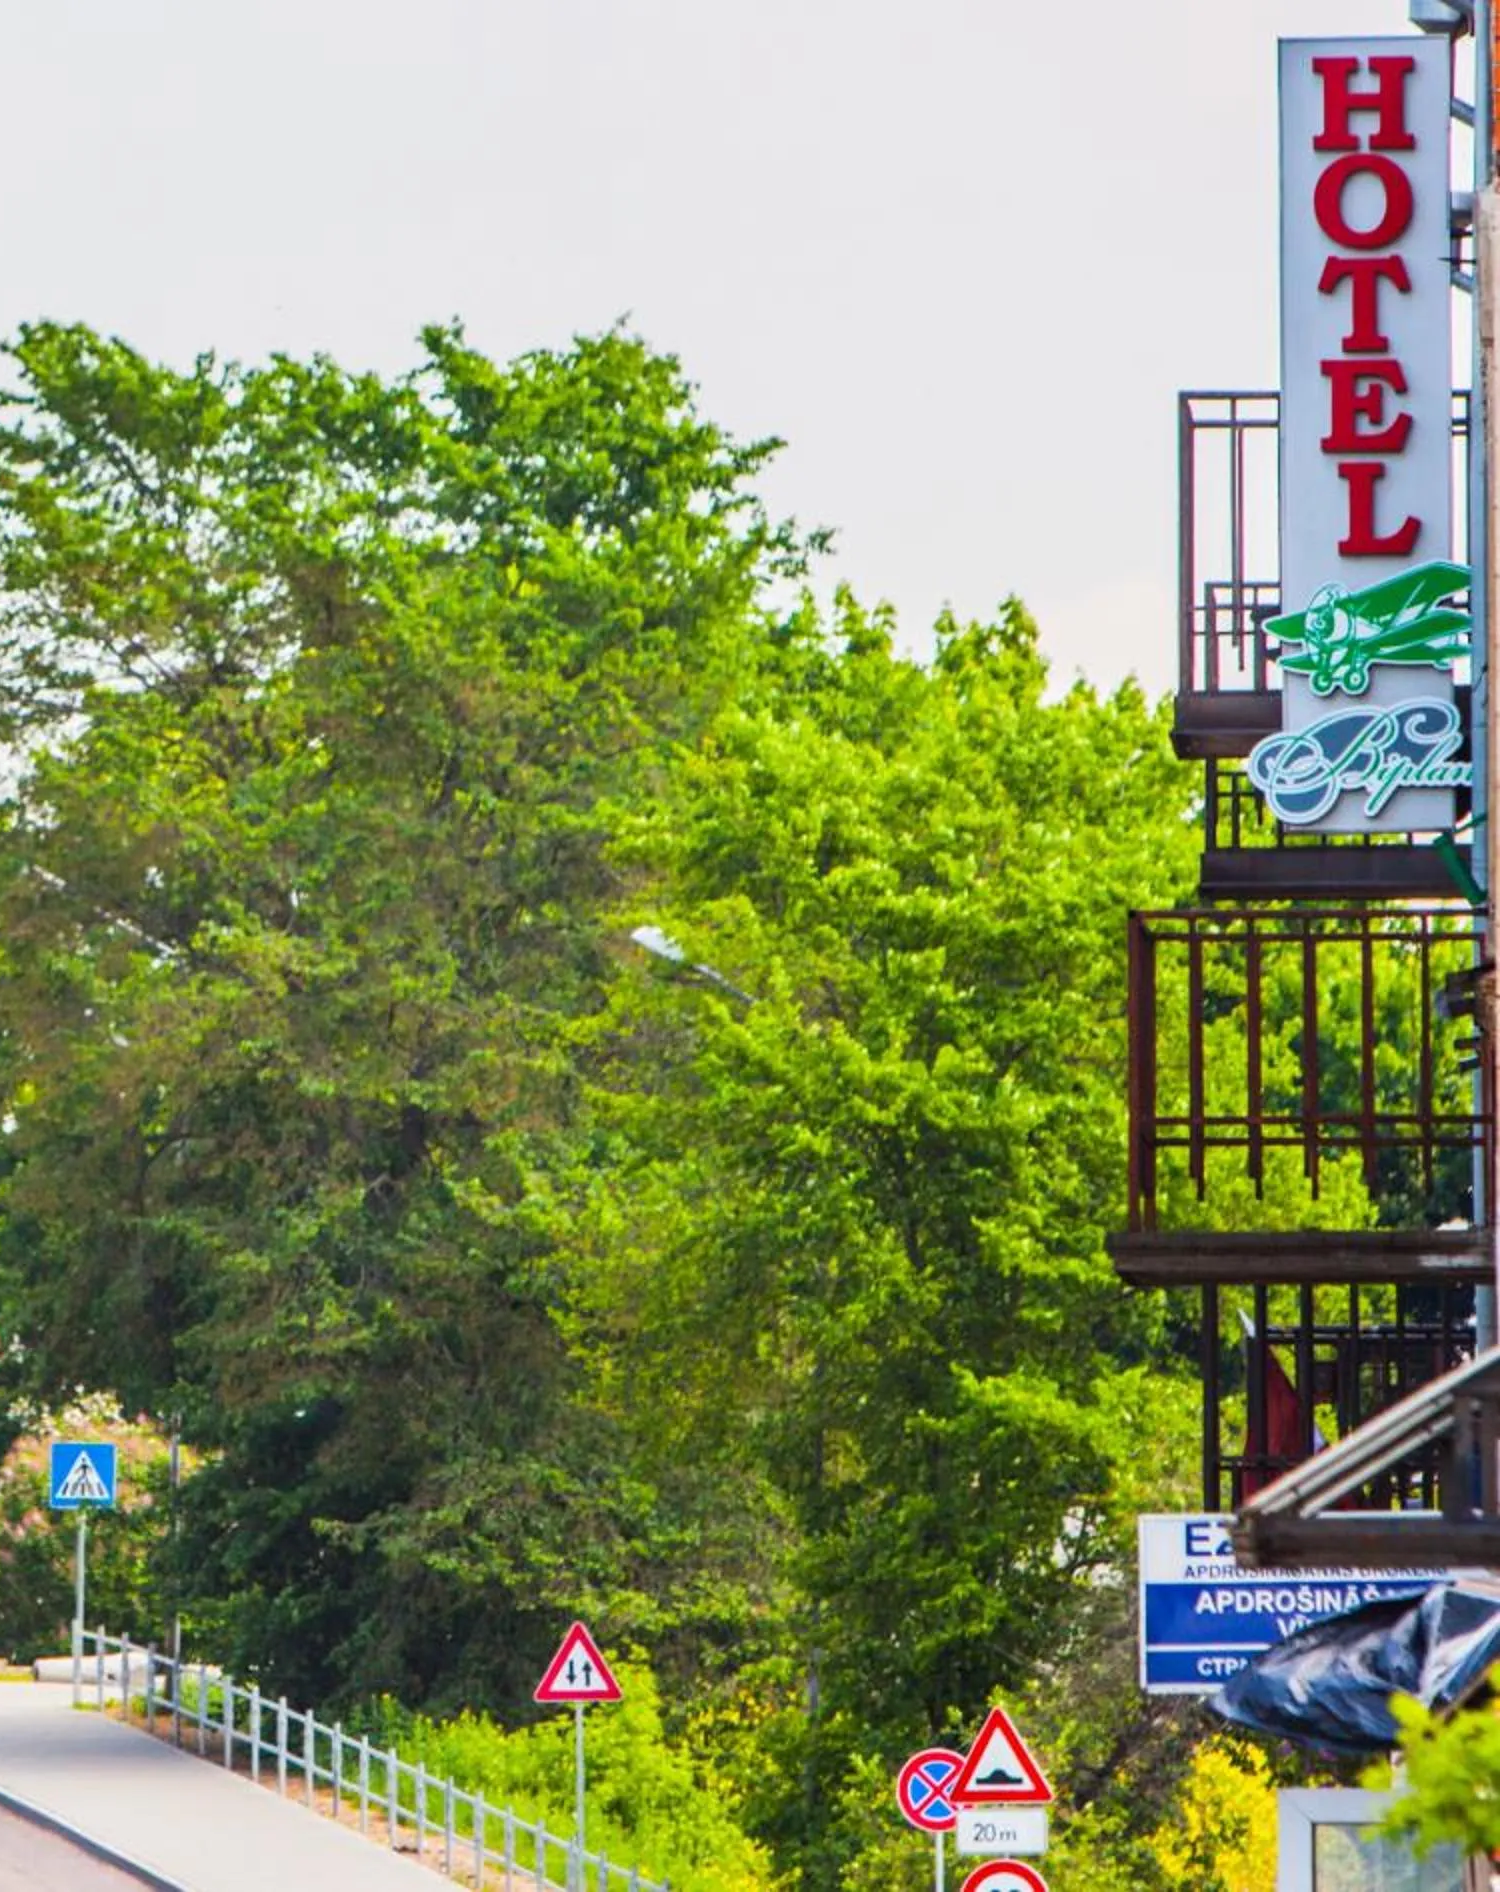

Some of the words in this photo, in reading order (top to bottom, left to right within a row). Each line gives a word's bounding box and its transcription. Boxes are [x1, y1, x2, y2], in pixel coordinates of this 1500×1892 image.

[1311, 56, 1422, 557] HOTEL
[1247, 697, 1473, 824] Biplan
[973, 1823, 997, 1842] 20
[999, 1829, 1017, 1841] m
